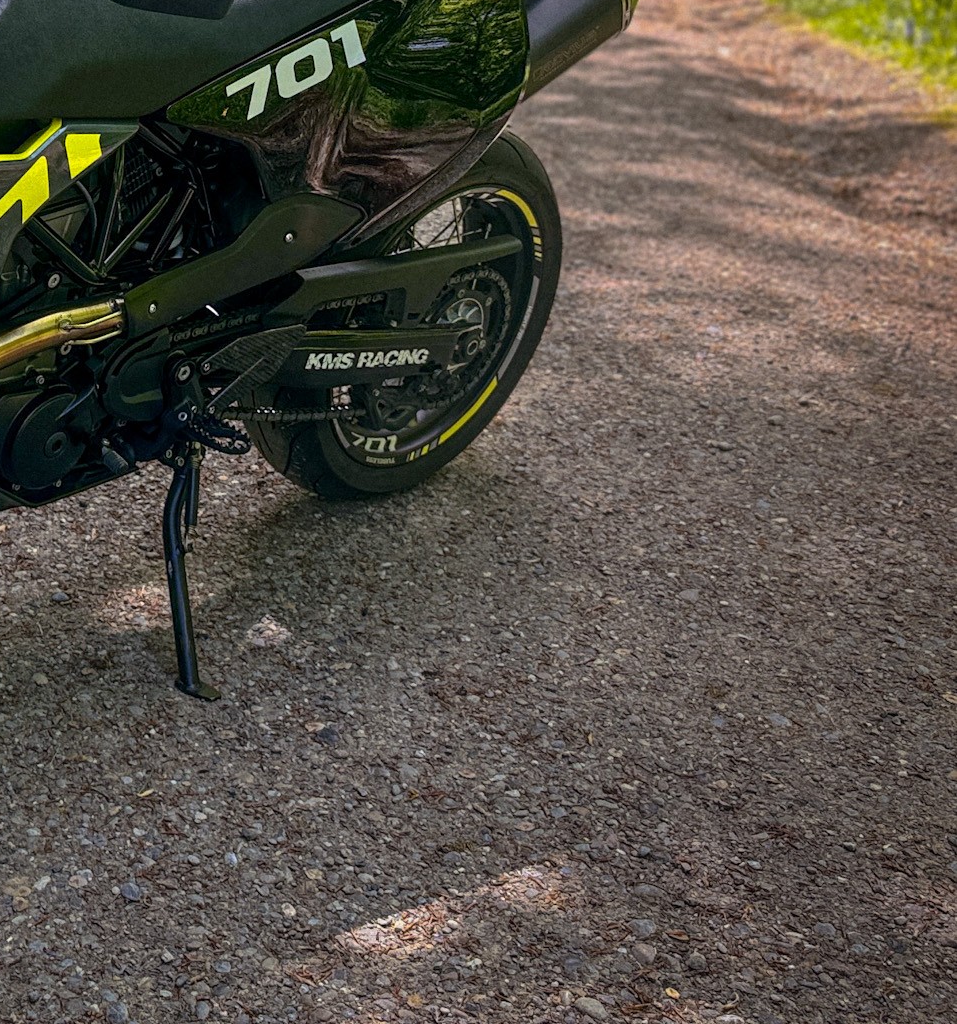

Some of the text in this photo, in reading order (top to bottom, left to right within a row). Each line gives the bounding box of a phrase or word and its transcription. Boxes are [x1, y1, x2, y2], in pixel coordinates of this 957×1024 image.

[225, 19, 367, 121] 701
[304, 348, 430, 370] KMS RACING
[351, 431, 397, 453] 701
